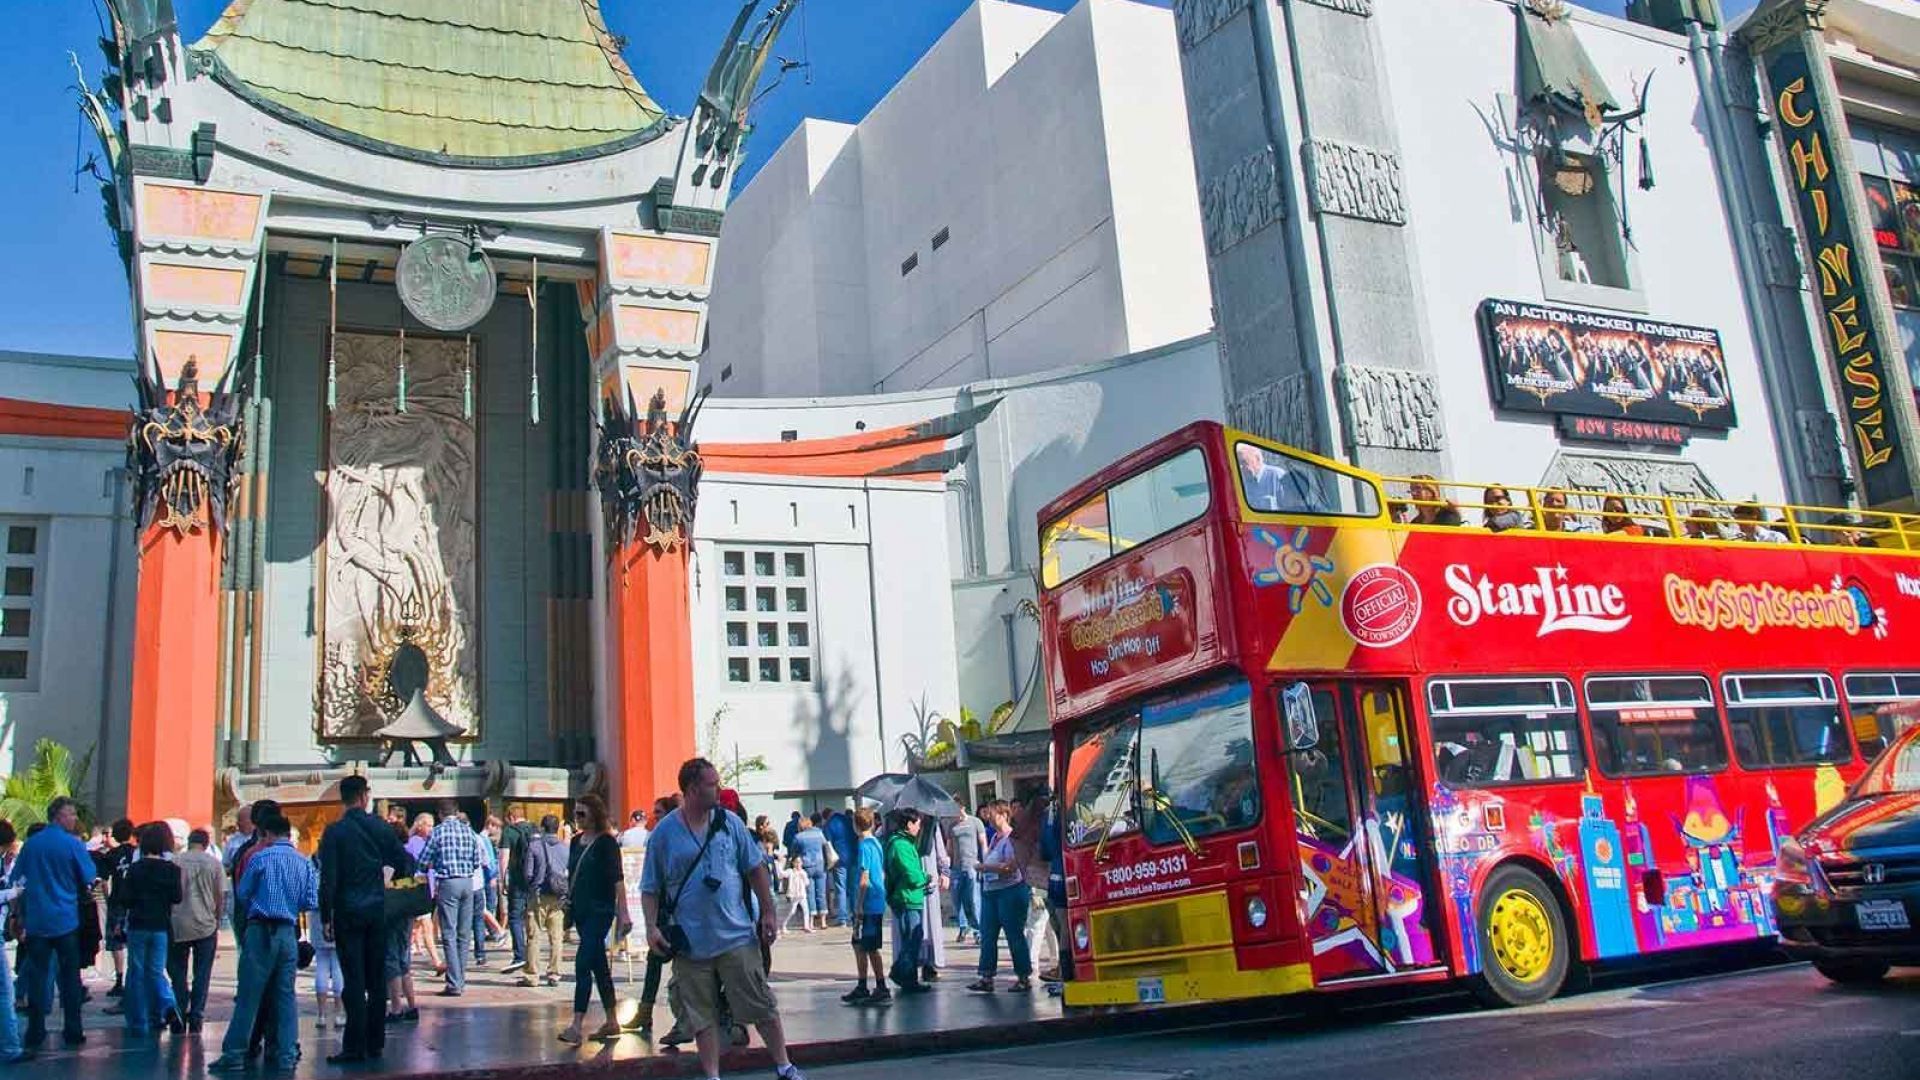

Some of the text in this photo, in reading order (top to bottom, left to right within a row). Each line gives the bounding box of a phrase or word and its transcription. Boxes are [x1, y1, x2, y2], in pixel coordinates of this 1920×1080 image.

[1779, 77, 1892, 469] CHINESE
[1575, 417, 1682, 443] NOW SHOWING
